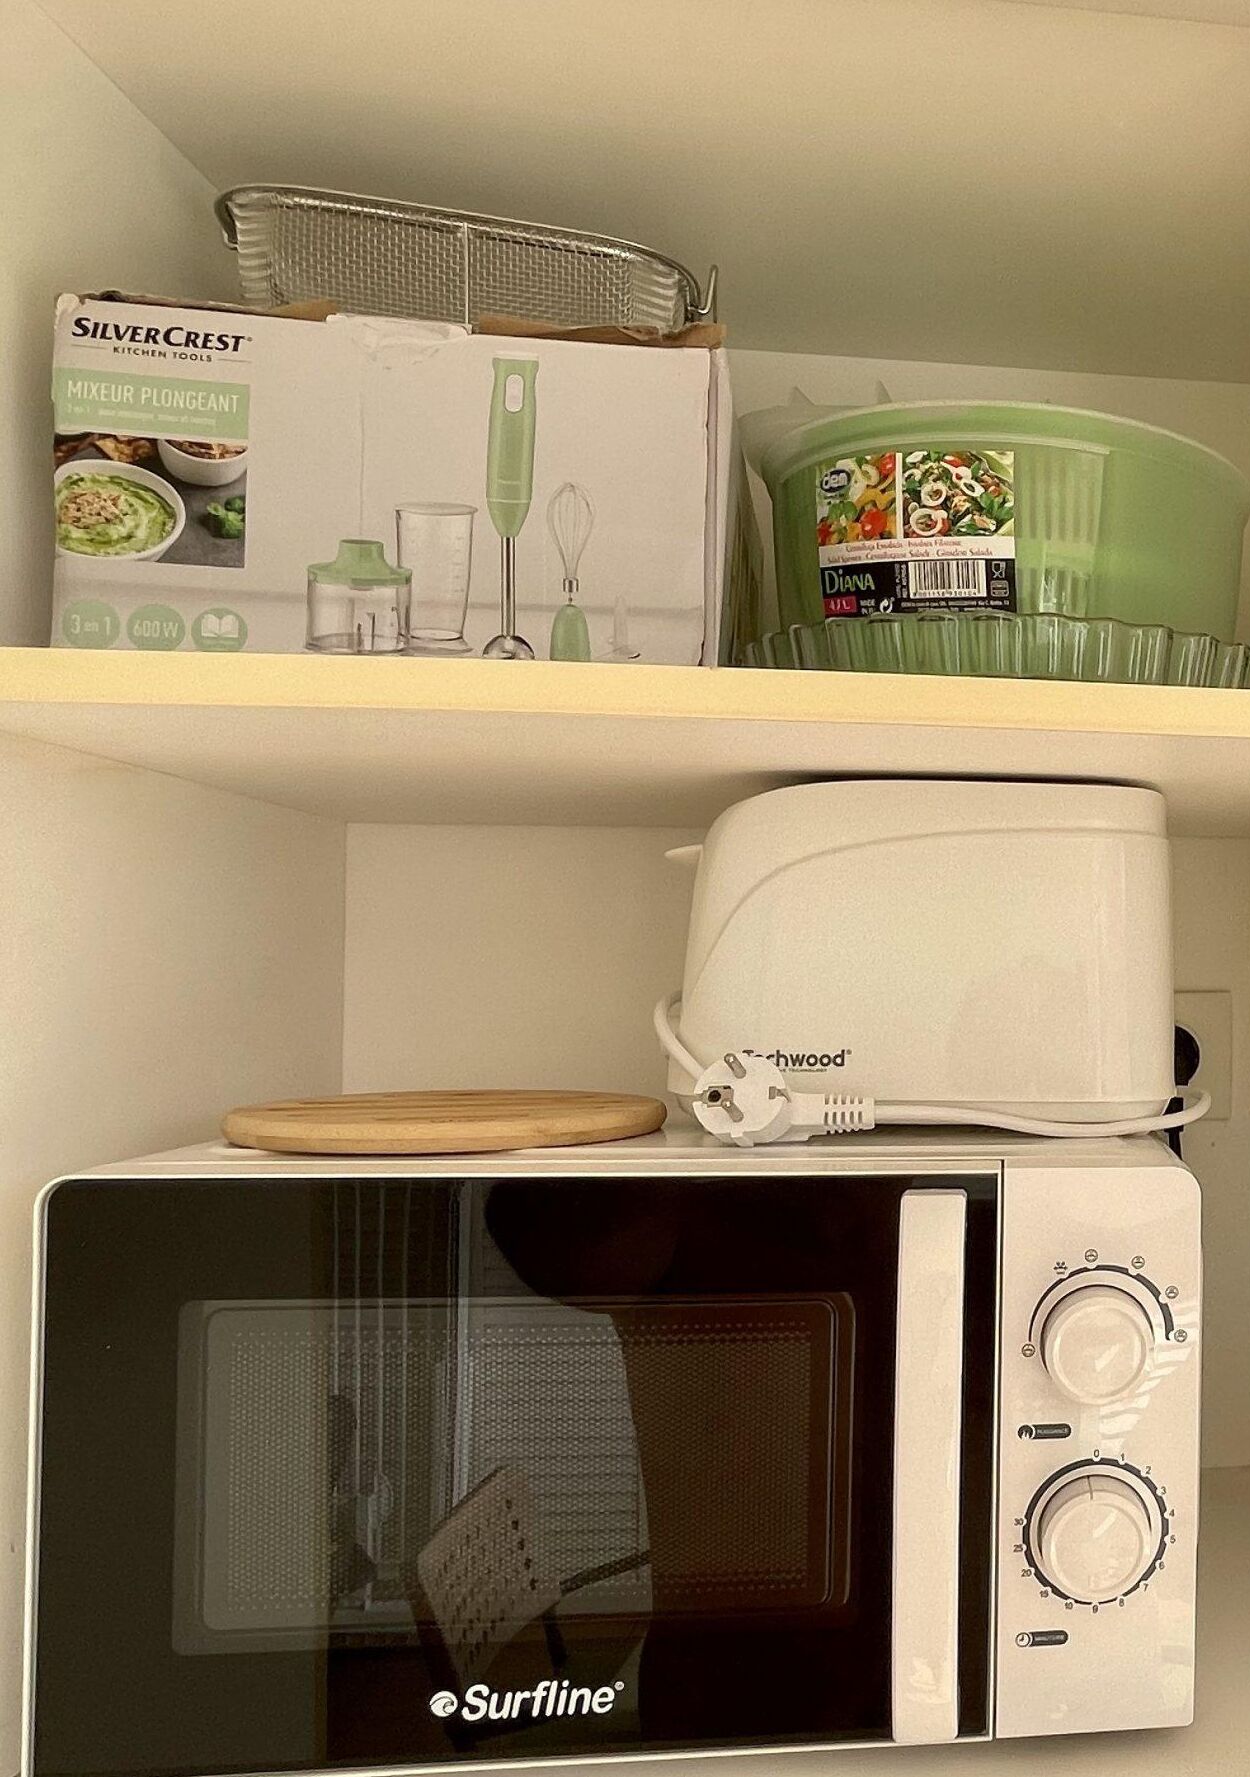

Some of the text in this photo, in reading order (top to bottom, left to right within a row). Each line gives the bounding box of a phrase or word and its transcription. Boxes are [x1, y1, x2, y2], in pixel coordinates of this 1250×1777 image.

[113, 346, 213, 363] KITCHEN TOOLS
[67, 379, 241, 414] MIXEUR PLONGEANT
[71, 614, 81, 635] 3
[104, 616, 112, 636] 1
[1093, 1449, 1100, 1458] 0
[1120, 1453, 1125, 1461] 1
[1145, 1466, 1151, 1474] 2
[1160, 1486, 1167, 1495] 3
[1169, 1509, 1175, 1517] 4
[1170, 1535, 1176, 1544] 5
[1013, 1544, 1024, 1552] 25
[1021, 1569, 1032, 1578] 20
[1142, 1583, 1149, 1592] 7
[461, 1679, 616, 1722] Surfline
